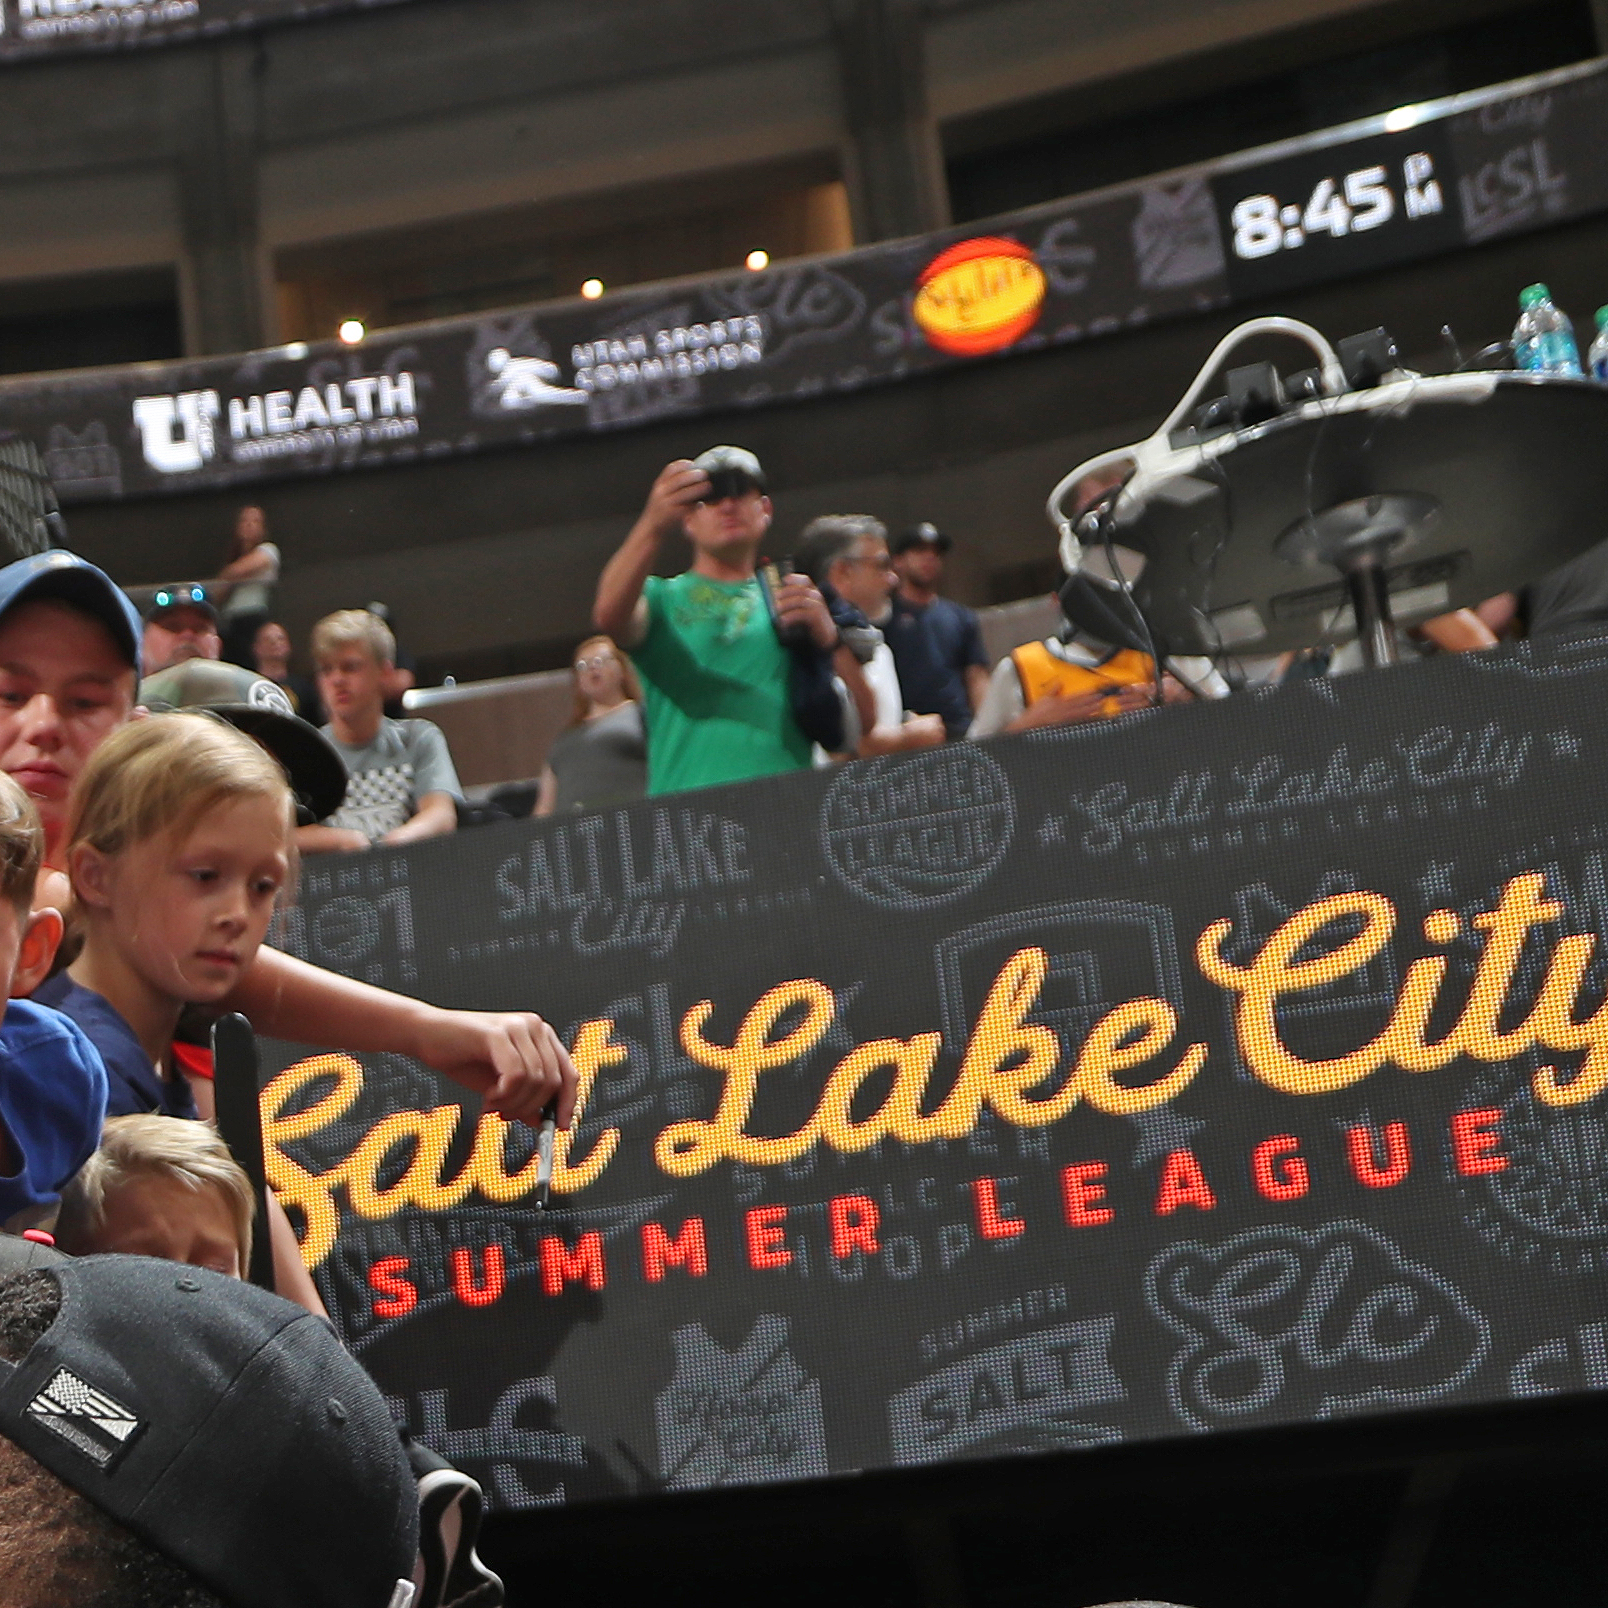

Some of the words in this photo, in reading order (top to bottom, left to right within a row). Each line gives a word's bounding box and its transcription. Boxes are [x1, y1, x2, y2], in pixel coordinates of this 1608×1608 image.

[1231, 164, 1396, 260] 8:45
[227, 369, 418, 440] HEALTH
[573, 338, 764, 394] COMMISSION
[495, 810, 605, 921] SALT
[619, 806, 752, 898] LAKE
[653, 945, 1210, 1178] Lake
[1194, 869, 1608, 1107] City
[366, 1193, 881, 1319] SUMMER
[970, 1105, 1510, 1240] LEAGUE
[919, 1281, 1069, 1361] SUMMER
[919, 1339, 1085, 1443] SALT
